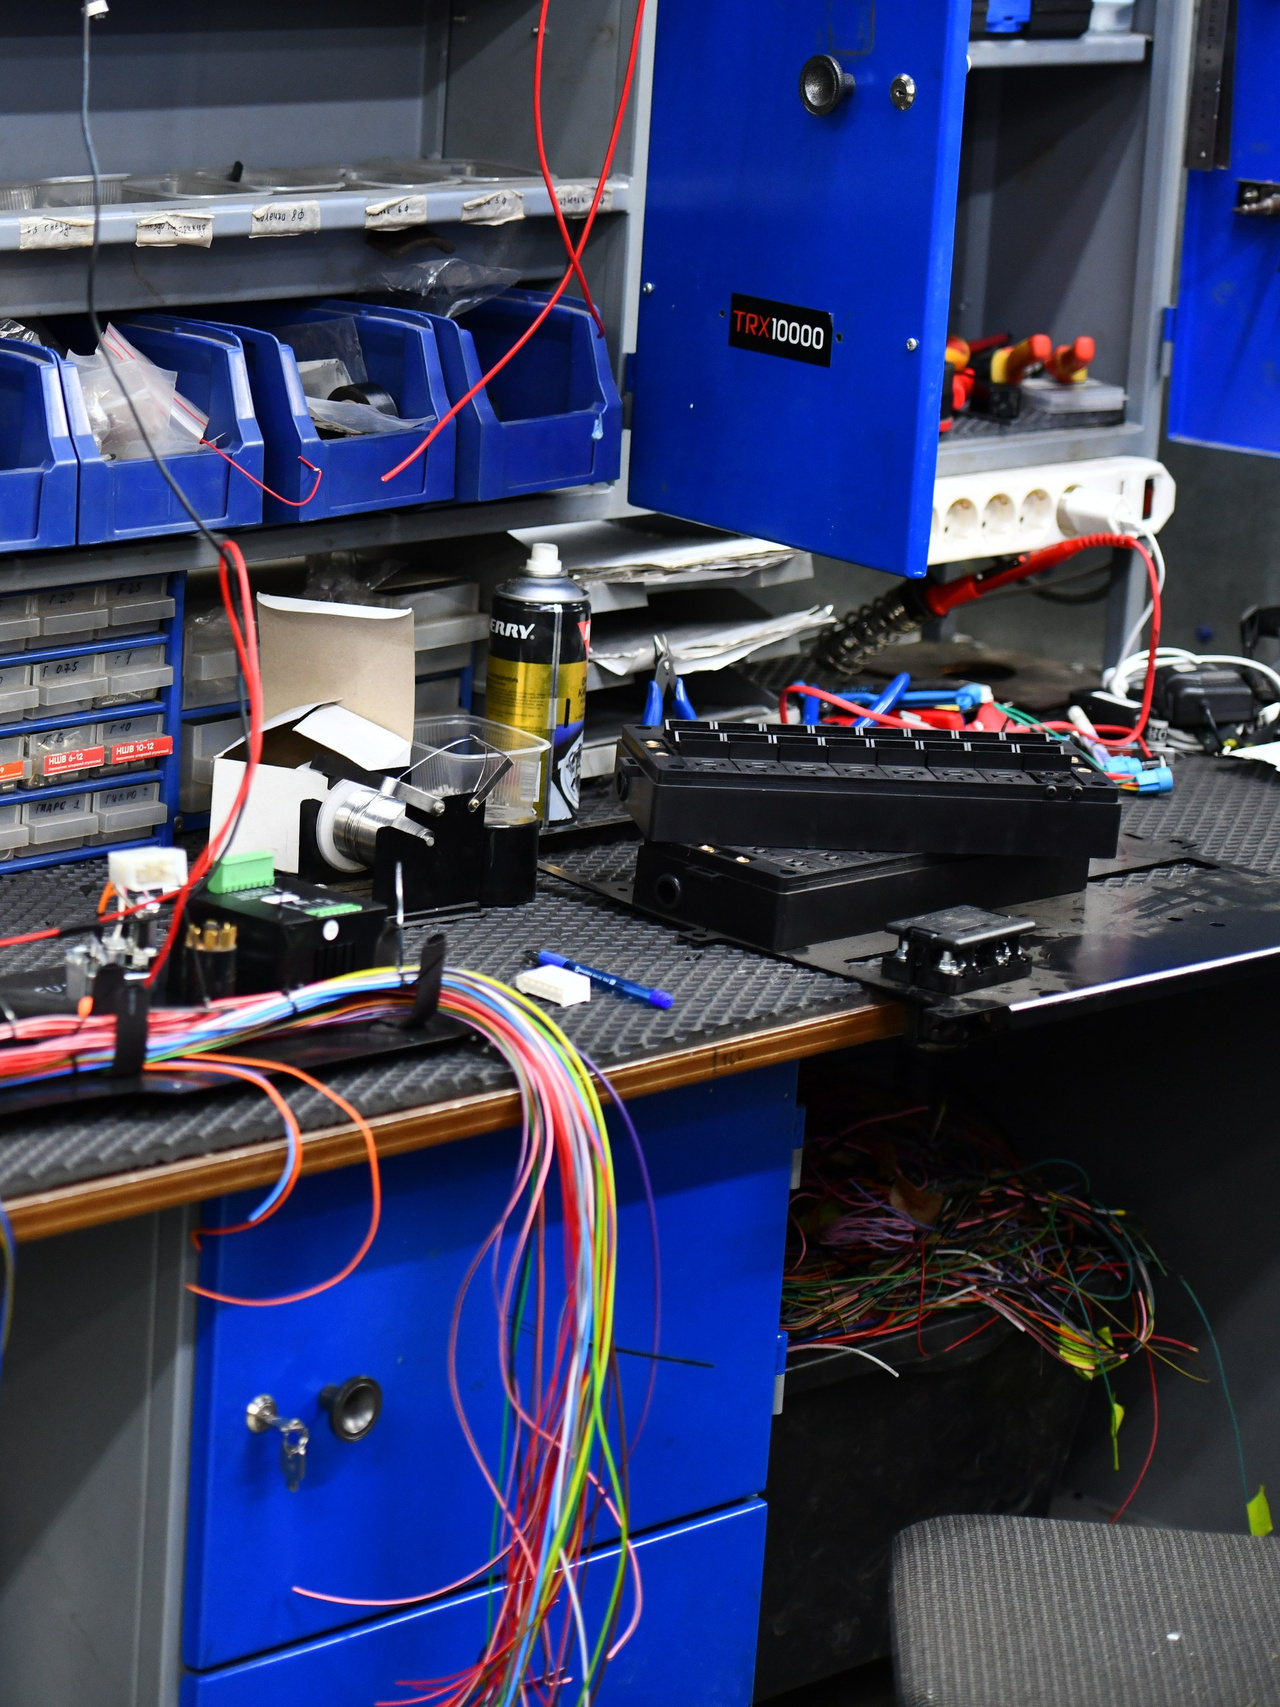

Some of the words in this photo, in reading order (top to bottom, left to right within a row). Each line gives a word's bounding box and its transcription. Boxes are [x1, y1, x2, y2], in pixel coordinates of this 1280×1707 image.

[733, 309, 825, 350] TRX10000
[490, 618, 535, 640] ERRY
[115, 744, 135, 756] НШВ
[136, 742, 155, 753] 10-12
[48, 755, 67, 766] НШВ
[68, 752, 84, 763] 6-12
